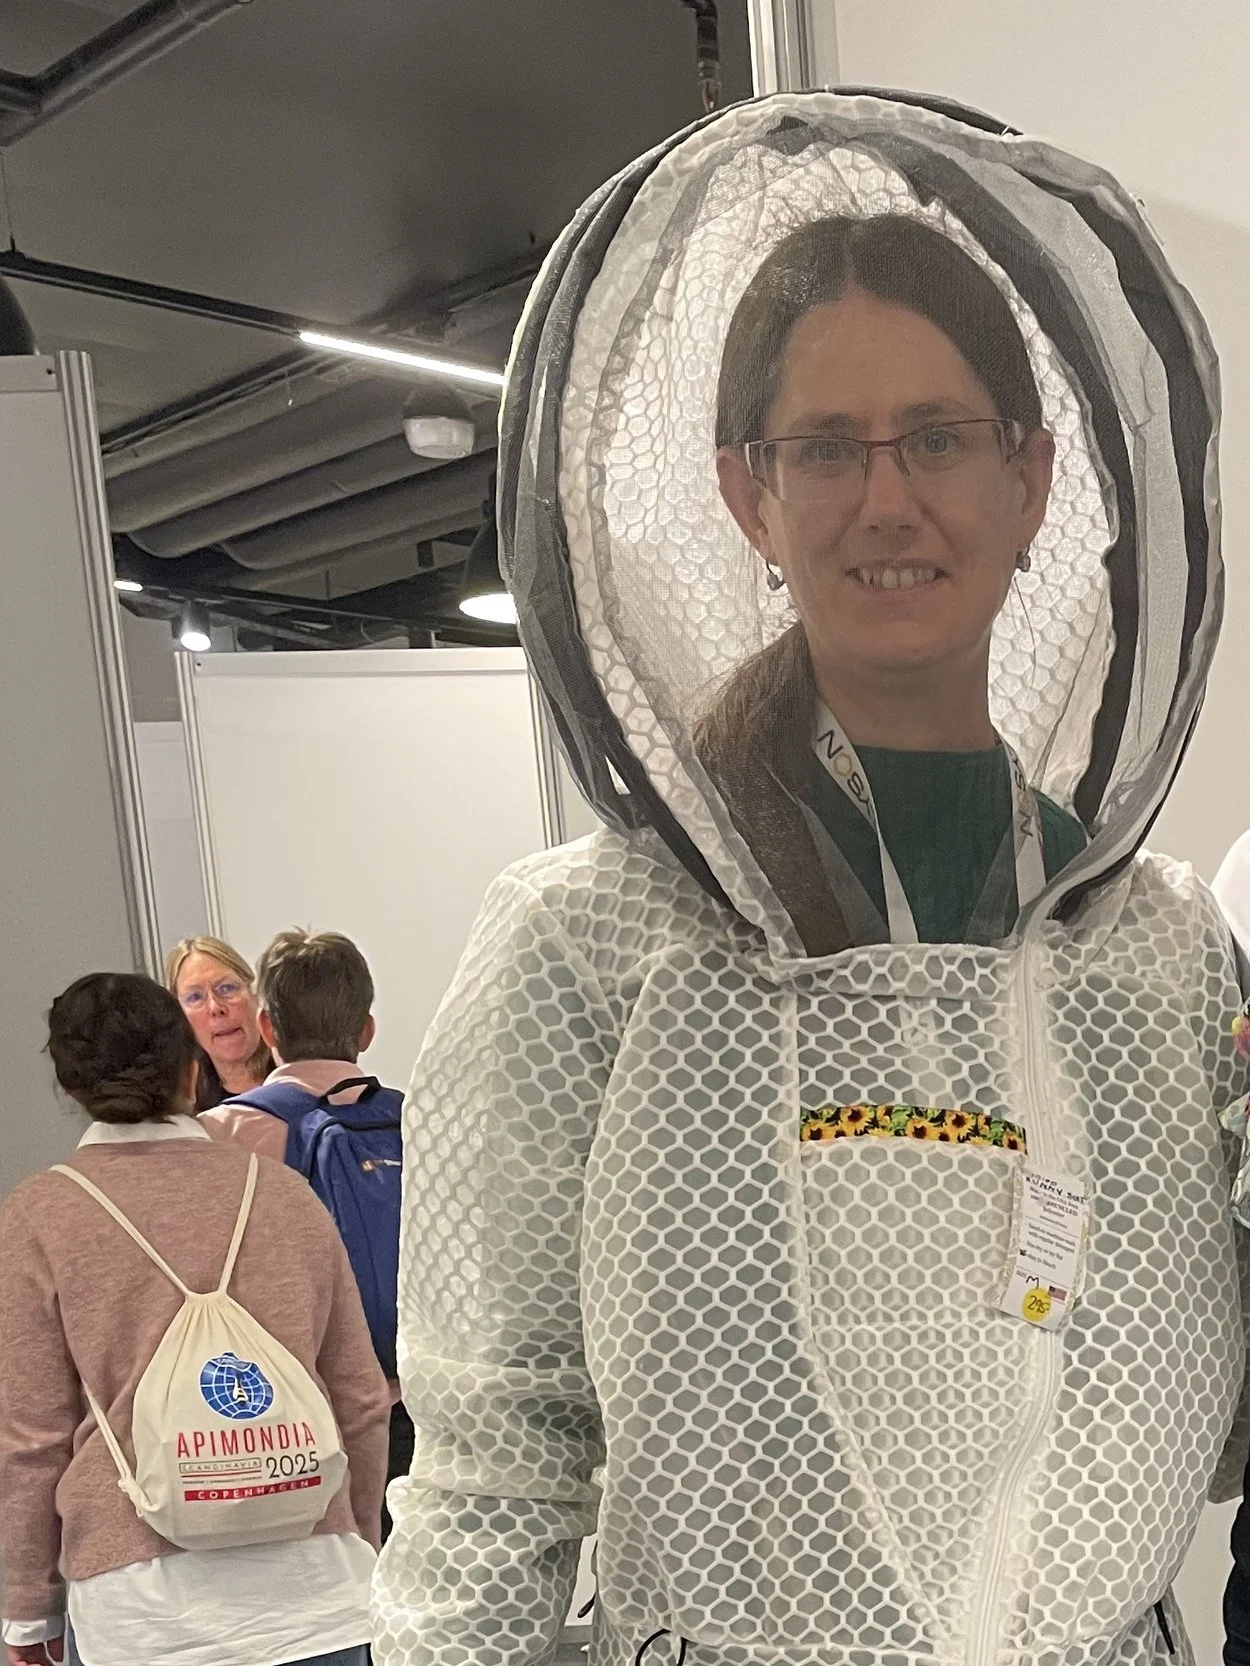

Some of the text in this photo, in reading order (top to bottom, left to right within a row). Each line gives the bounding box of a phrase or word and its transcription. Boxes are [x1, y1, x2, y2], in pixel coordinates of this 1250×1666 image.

[177, 1422, 316, 1458] APIMONDIA
[182, 1461, 259, 1472] SCANDINAVIA
[266, 1451, 320, 1479] 2025
[197, 1481, 309, 1500] COPENHAGEN
